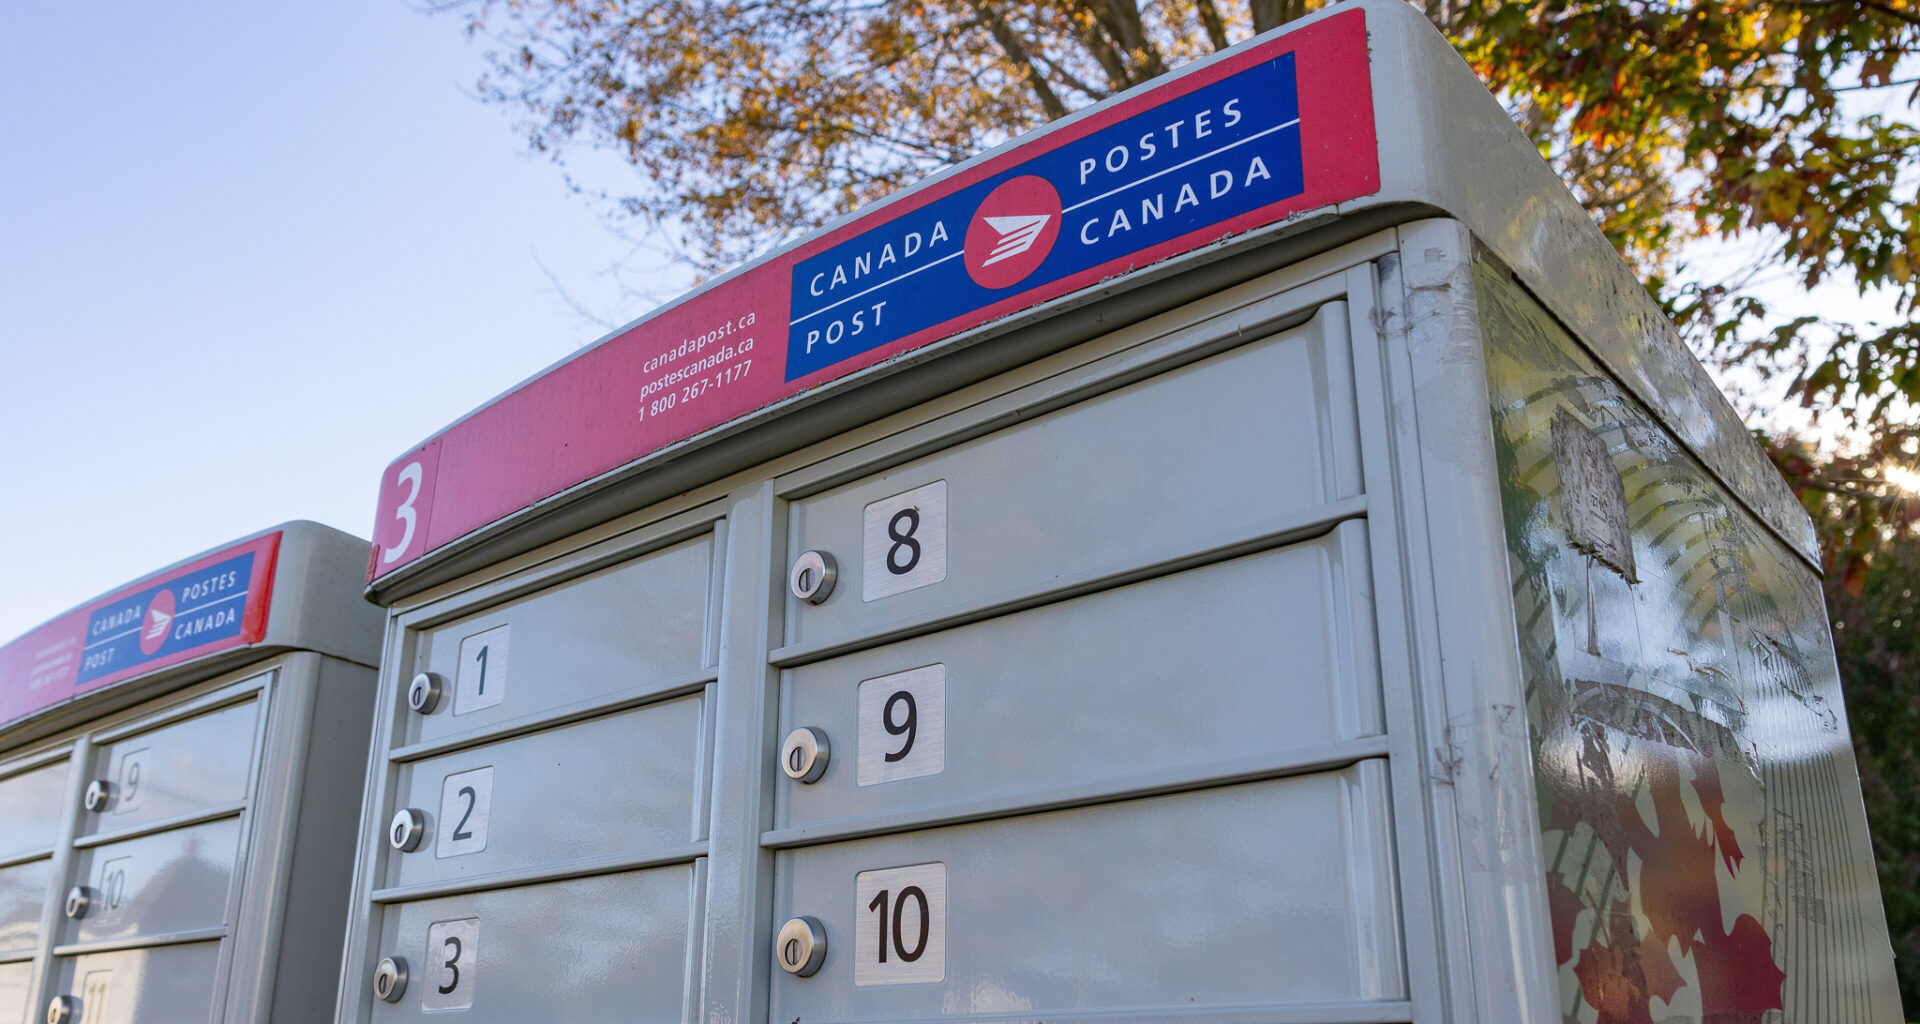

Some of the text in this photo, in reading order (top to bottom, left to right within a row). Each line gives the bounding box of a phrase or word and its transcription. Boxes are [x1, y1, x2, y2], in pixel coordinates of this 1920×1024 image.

[1079, 98, 1242, 186] POSTES
[1080, 155, 1272, 246] CANADA
[810, 220, 949, 297] CANADA
[643, 311, 756, 374] canadapost.ca
[806, 301, 887, 355] POST
[638, 359, 752, 422] 1 800 267-1177
[640, 337, 754, 403] postescanada.ca
[383, 461, 423, 564] 3
[886, 506, 922, 576] 8
[182, 570, 237, 603] POSTES
[92, 604, 142, 637] CANADA
[174, 607, 236, 640] CANADA
[84, 647, 116, 672] POST
[475, 645, 489, 696] 1
[882, 690, 918, 763] 9
[124, 762, 140, 802] 9
[452, 786, 477, 842] 2
[104, 868, 126, 910] 10
[868, 885, 930, 964] 10
[438, 936, 462, 995] 3
[87, 983, 107, 1024] 11
